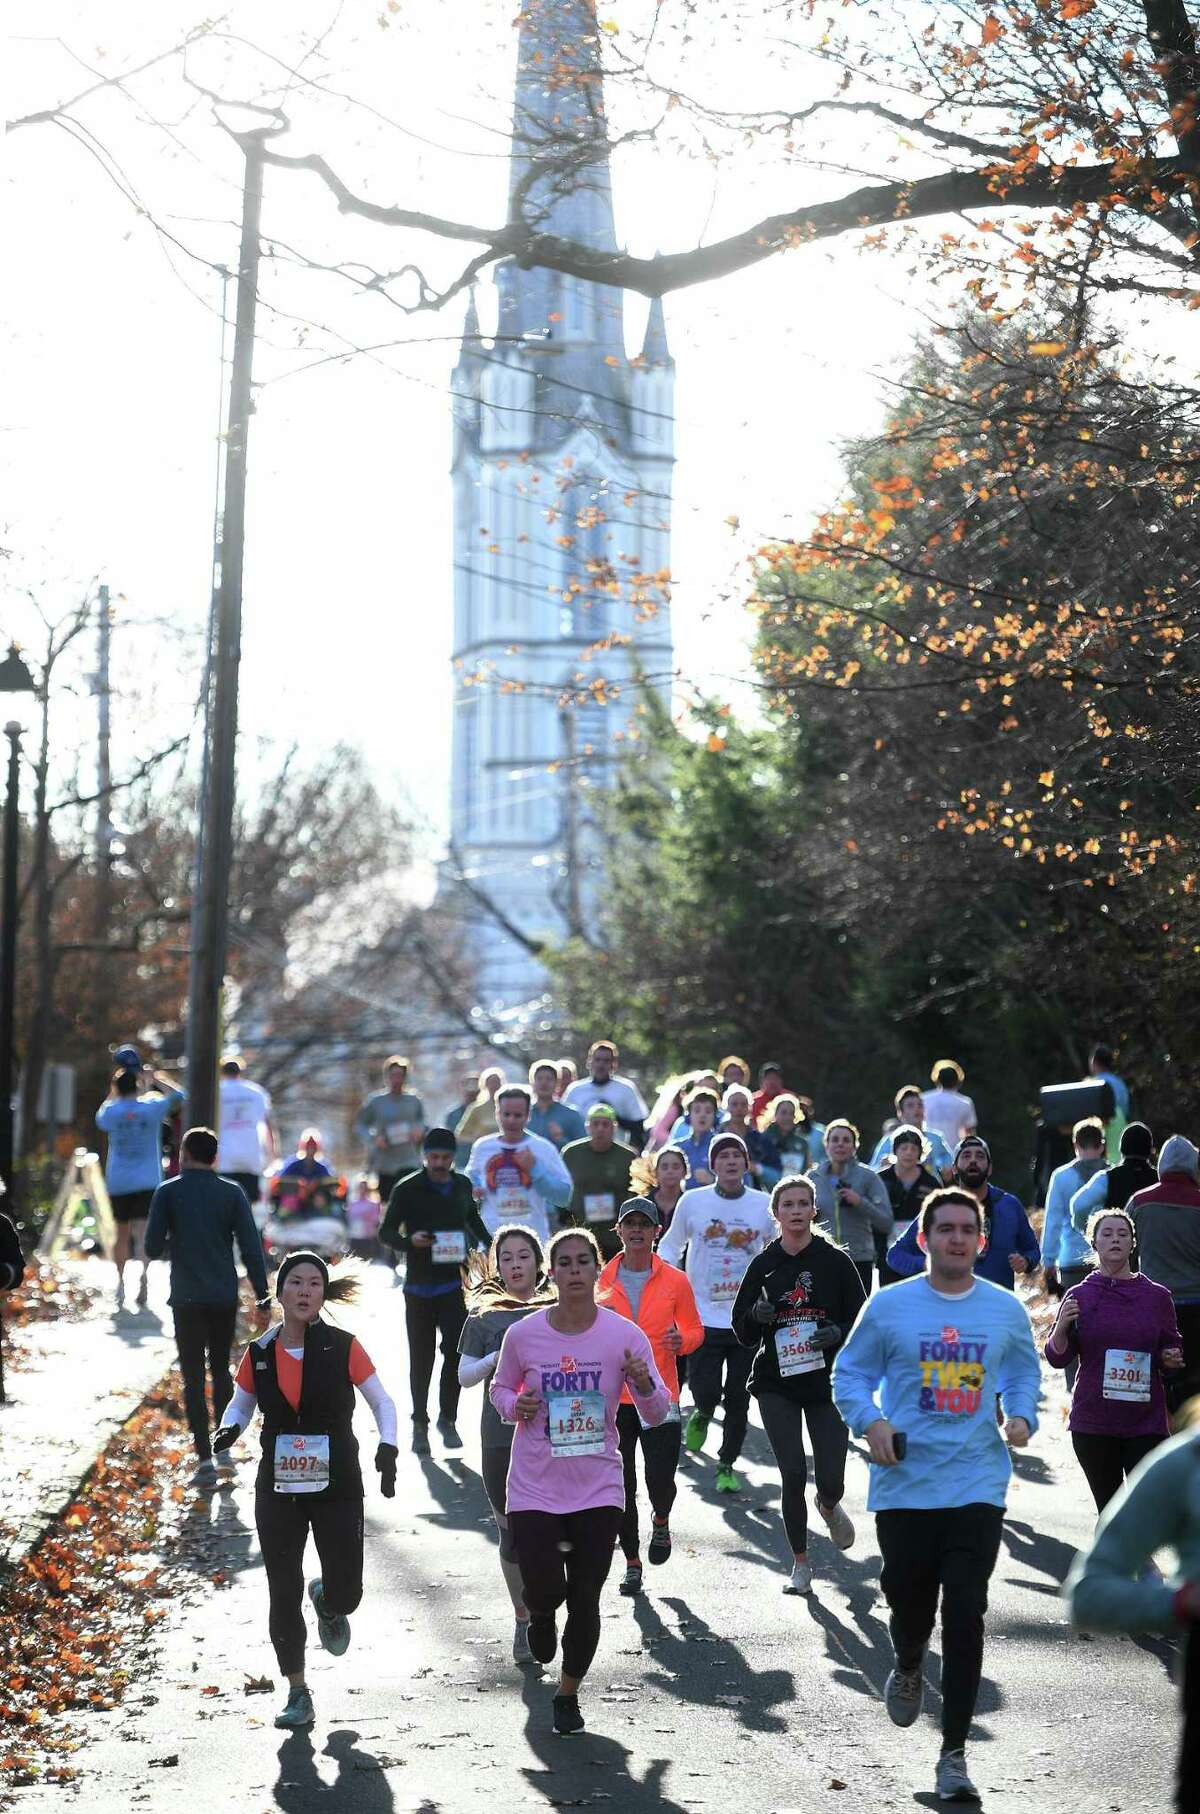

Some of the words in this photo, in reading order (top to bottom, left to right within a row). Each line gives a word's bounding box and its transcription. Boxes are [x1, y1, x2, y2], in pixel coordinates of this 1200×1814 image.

[919, 1341, 988, 1362] FORTY
[541, 1370, 602, 1392] FORTY
[919, 1360, 984, 1390] TWO
[1109, 1367, 1141, 1382] 3201
[559, 1416, 595, 1434] 1326
[280, 1456, 318, 1472] 2097
